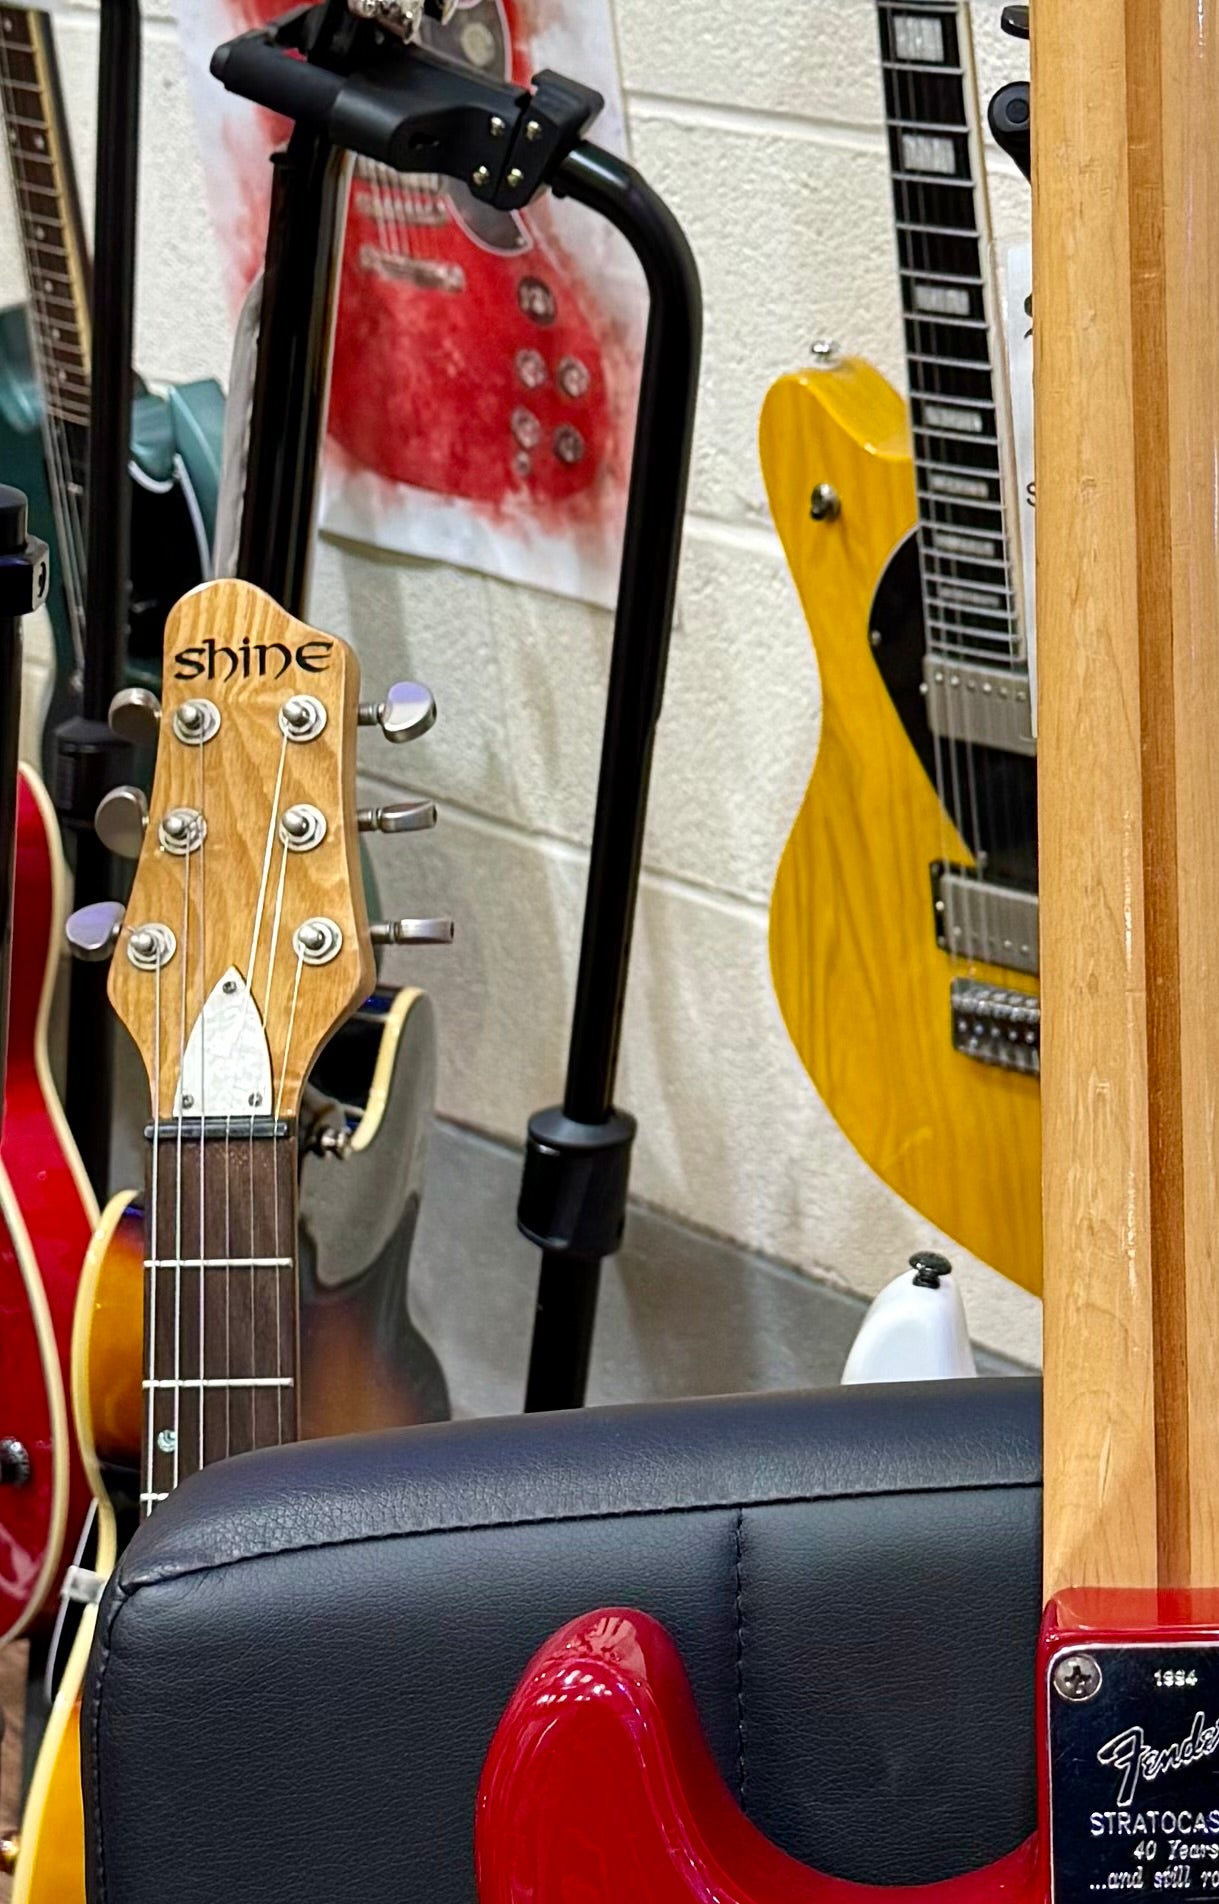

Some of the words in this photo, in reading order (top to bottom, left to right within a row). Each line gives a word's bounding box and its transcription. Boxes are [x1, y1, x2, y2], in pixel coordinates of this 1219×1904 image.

[174, 636, 335, 683] shine
[1133, 1841, 1157, 1861] 40
[1168, 1840, 1219, 1860] Years
[1154, 1866, 1191, 1889] still
